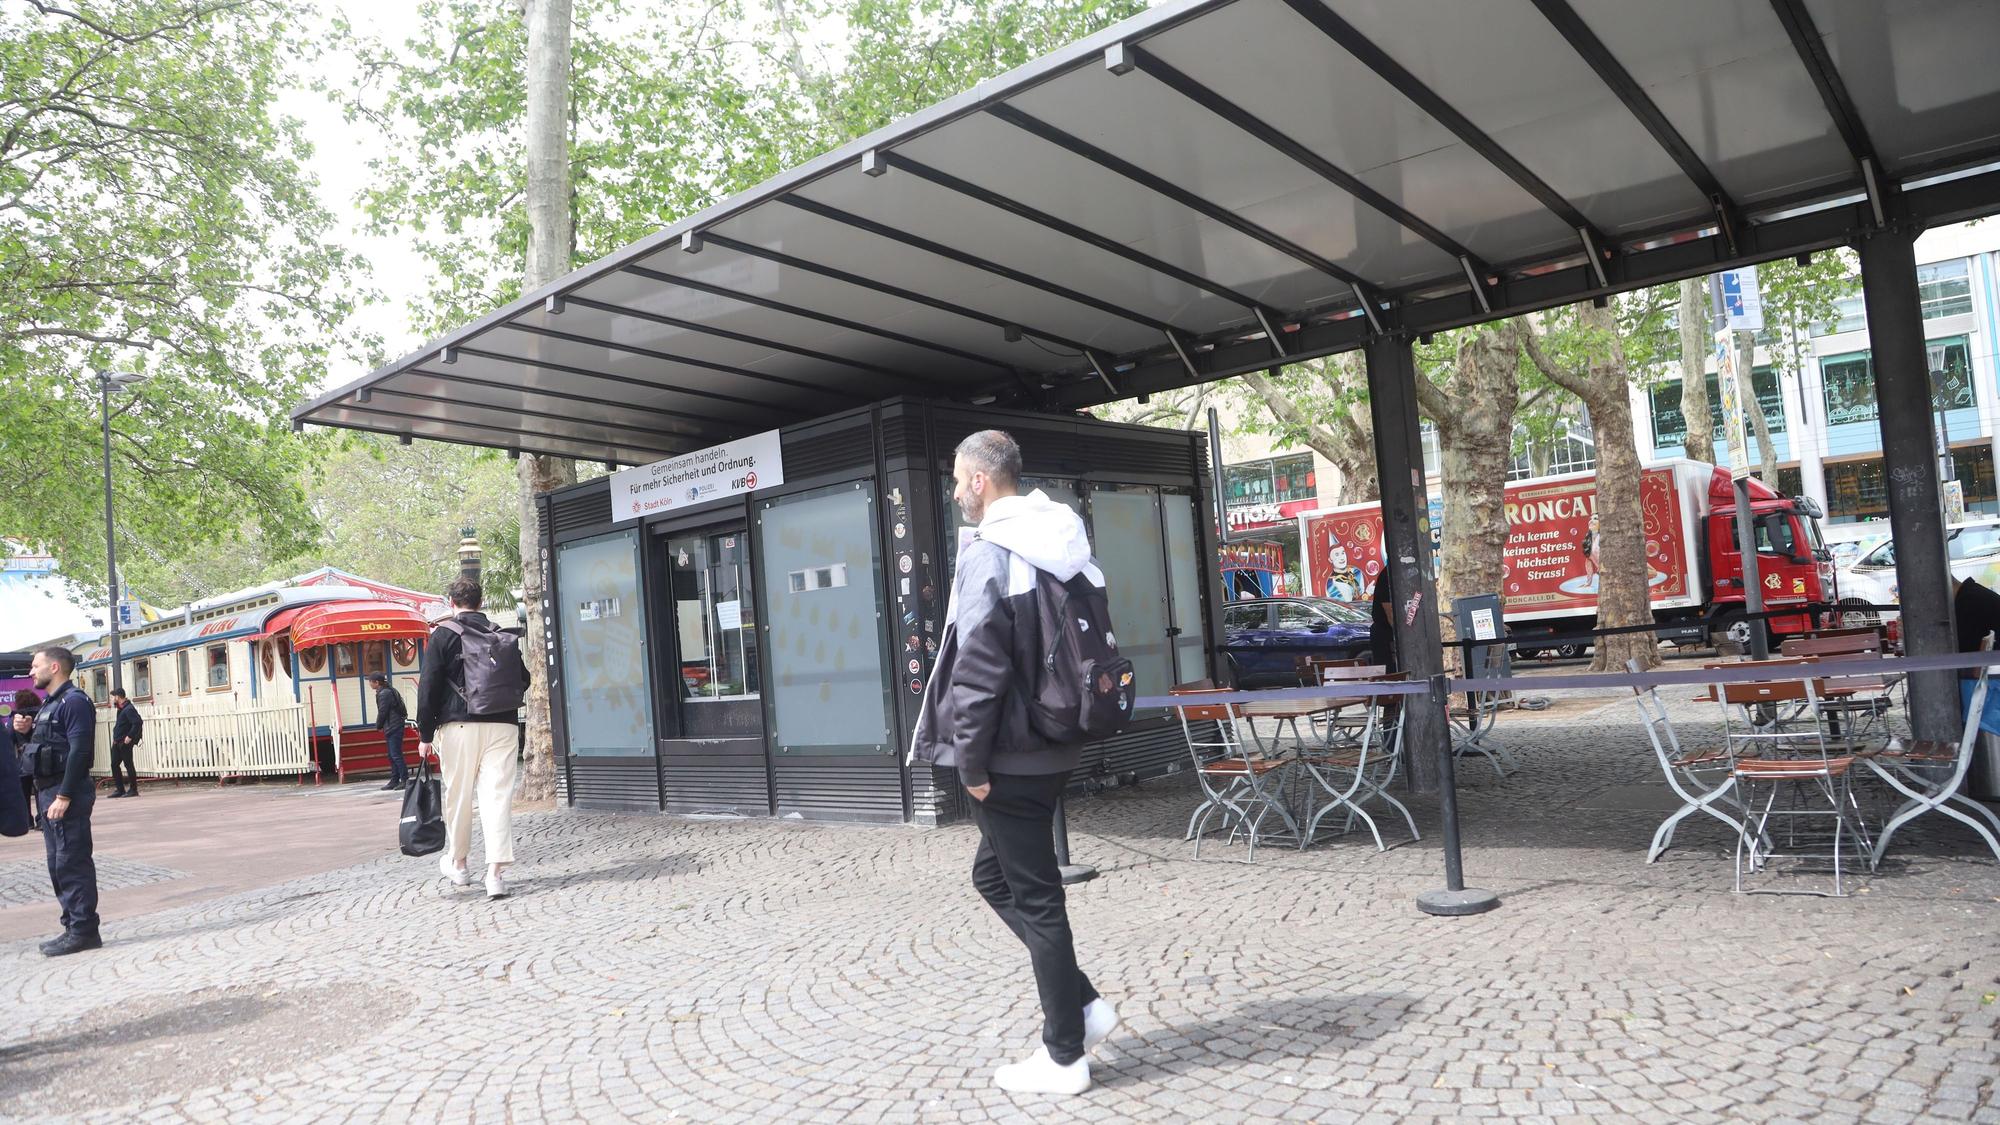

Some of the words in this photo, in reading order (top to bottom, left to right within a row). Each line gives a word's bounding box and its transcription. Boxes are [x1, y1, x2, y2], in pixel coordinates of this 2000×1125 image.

[651, 456, 694, 476] Gemeinsam
[695, 448, 729, 464] handeln.
[630, 482, 641, 495] Für
[642, 476, 661, 491] mehr
[662, 467, 700, 487] Sicherheit
[701, 463, 717, 477] und
[719, 455, 756, 473] Ordnung.
[731, 477, 746, 490] KVB
[644, 499, 660, 511] Stadt
[660, 497, 673, 507] Köln
[1508, 533, 1525, 544] Ich
[1527, 530, 1559, 542] kenne
[1503, 545, 1538, 557] keinen
[1540, 541, 1576, 553] Stress,
[1516, 554, 1570, 569] höchstens
[1527, 567, 1565, 581] Strass!
[360, 622, 392, 631] BÜRO
